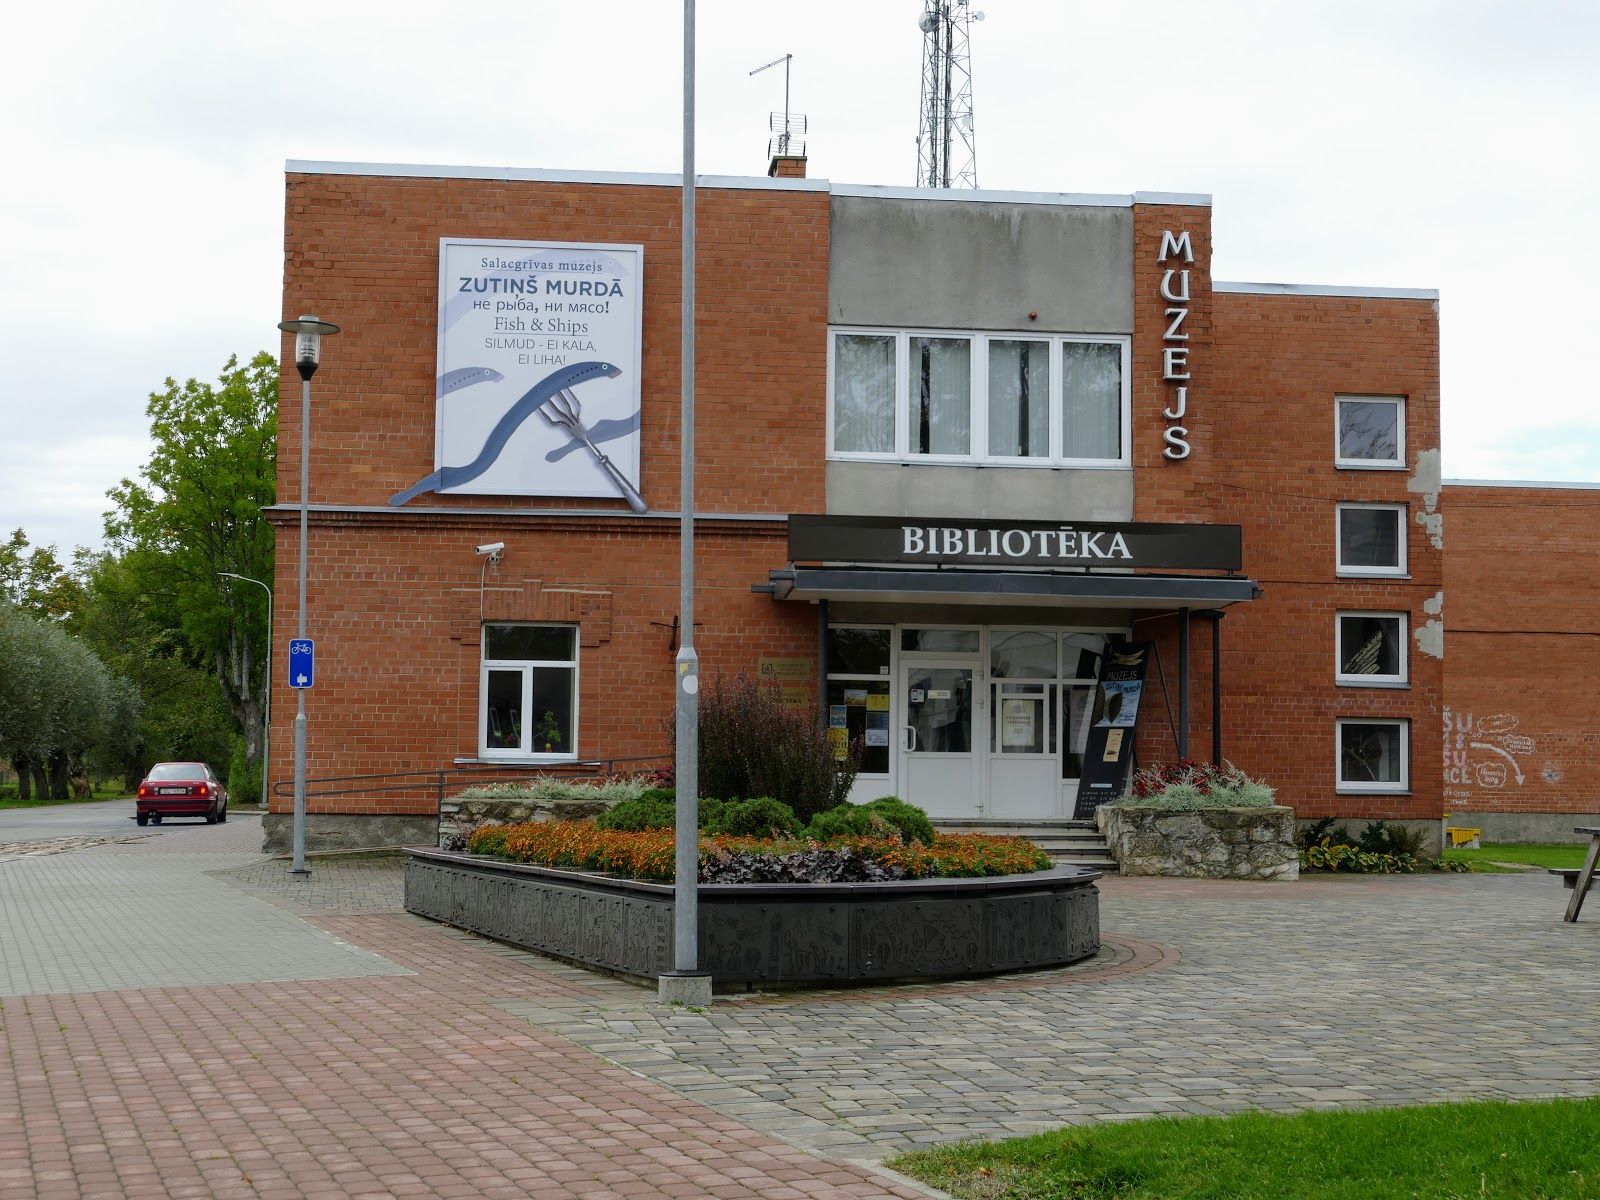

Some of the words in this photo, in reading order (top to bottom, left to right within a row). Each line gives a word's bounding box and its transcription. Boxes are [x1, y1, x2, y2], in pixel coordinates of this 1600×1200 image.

[481, 257, 554, 272] Salacgrīvas
[558, 261, 603, 272] muzejs
[459, 275, 538, 299] ZUTIŅŠ
[546, 279, 624, 297] MURDĀ
[473, 300, 491, 310] не
[496, 298, 540, 313] рыба,
[545, 302, 563, 312] ни
[568, 301, 609, 313] мясо!
[494, 316, 526, 332] Fish
[530, 317, 544, 332] &
[547, 317, 588, 336] Ships
[484, 337, 536, 350] SILMUD
[547, 339, 559, 350] EI
[562, 340, 597, 352] KALA,
[1157, 230, 1195, 460] MUZEJS
[518, 353, 530, 364] EI
[533, 354, 566, 365] LIHA!
[901, 526, 1134, 559] BIBLIOTĒKA
